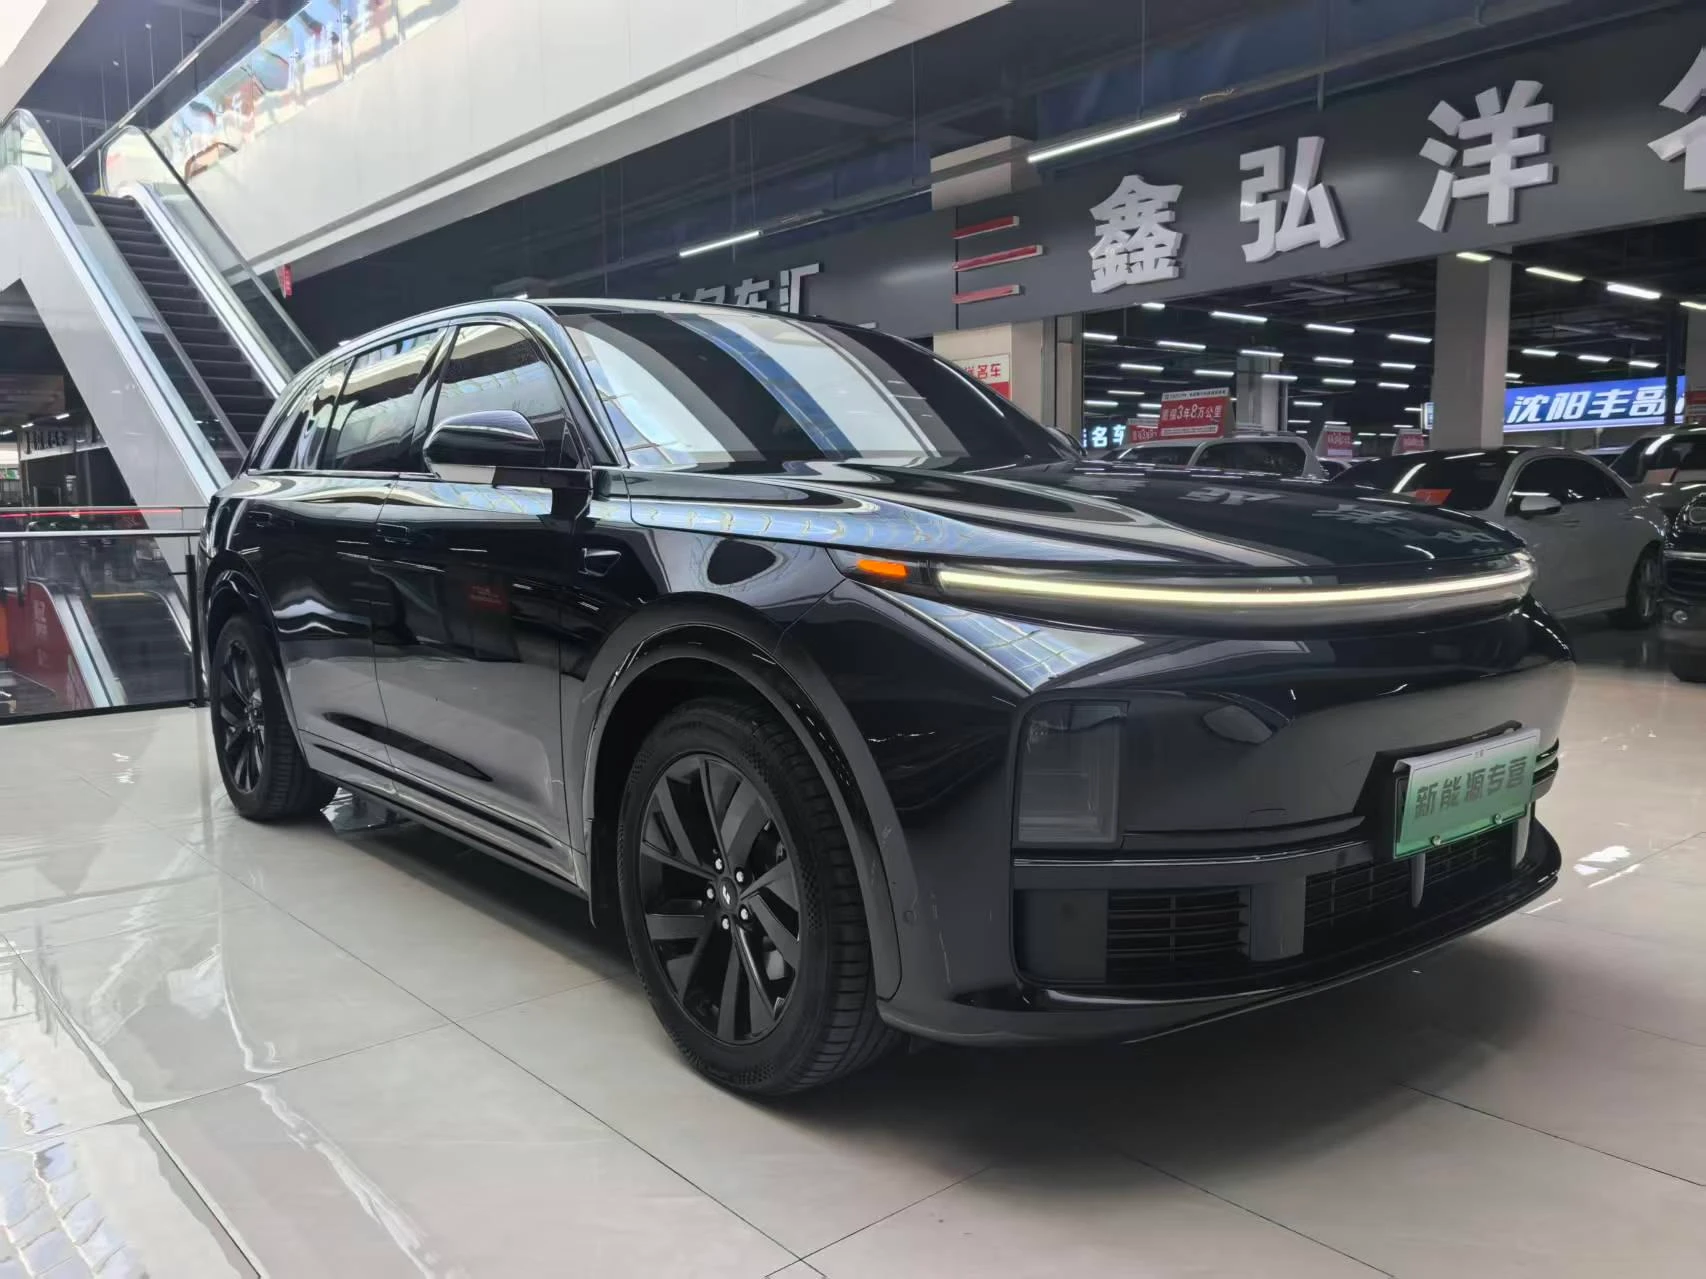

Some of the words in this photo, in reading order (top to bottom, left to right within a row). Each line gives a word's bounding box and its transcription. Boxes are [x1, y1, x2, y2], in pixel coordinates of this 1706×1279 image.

[1507, 385, 1685, 424] 沈阳丰哥
[1415, 756, 1528, 818] 新能源专营
